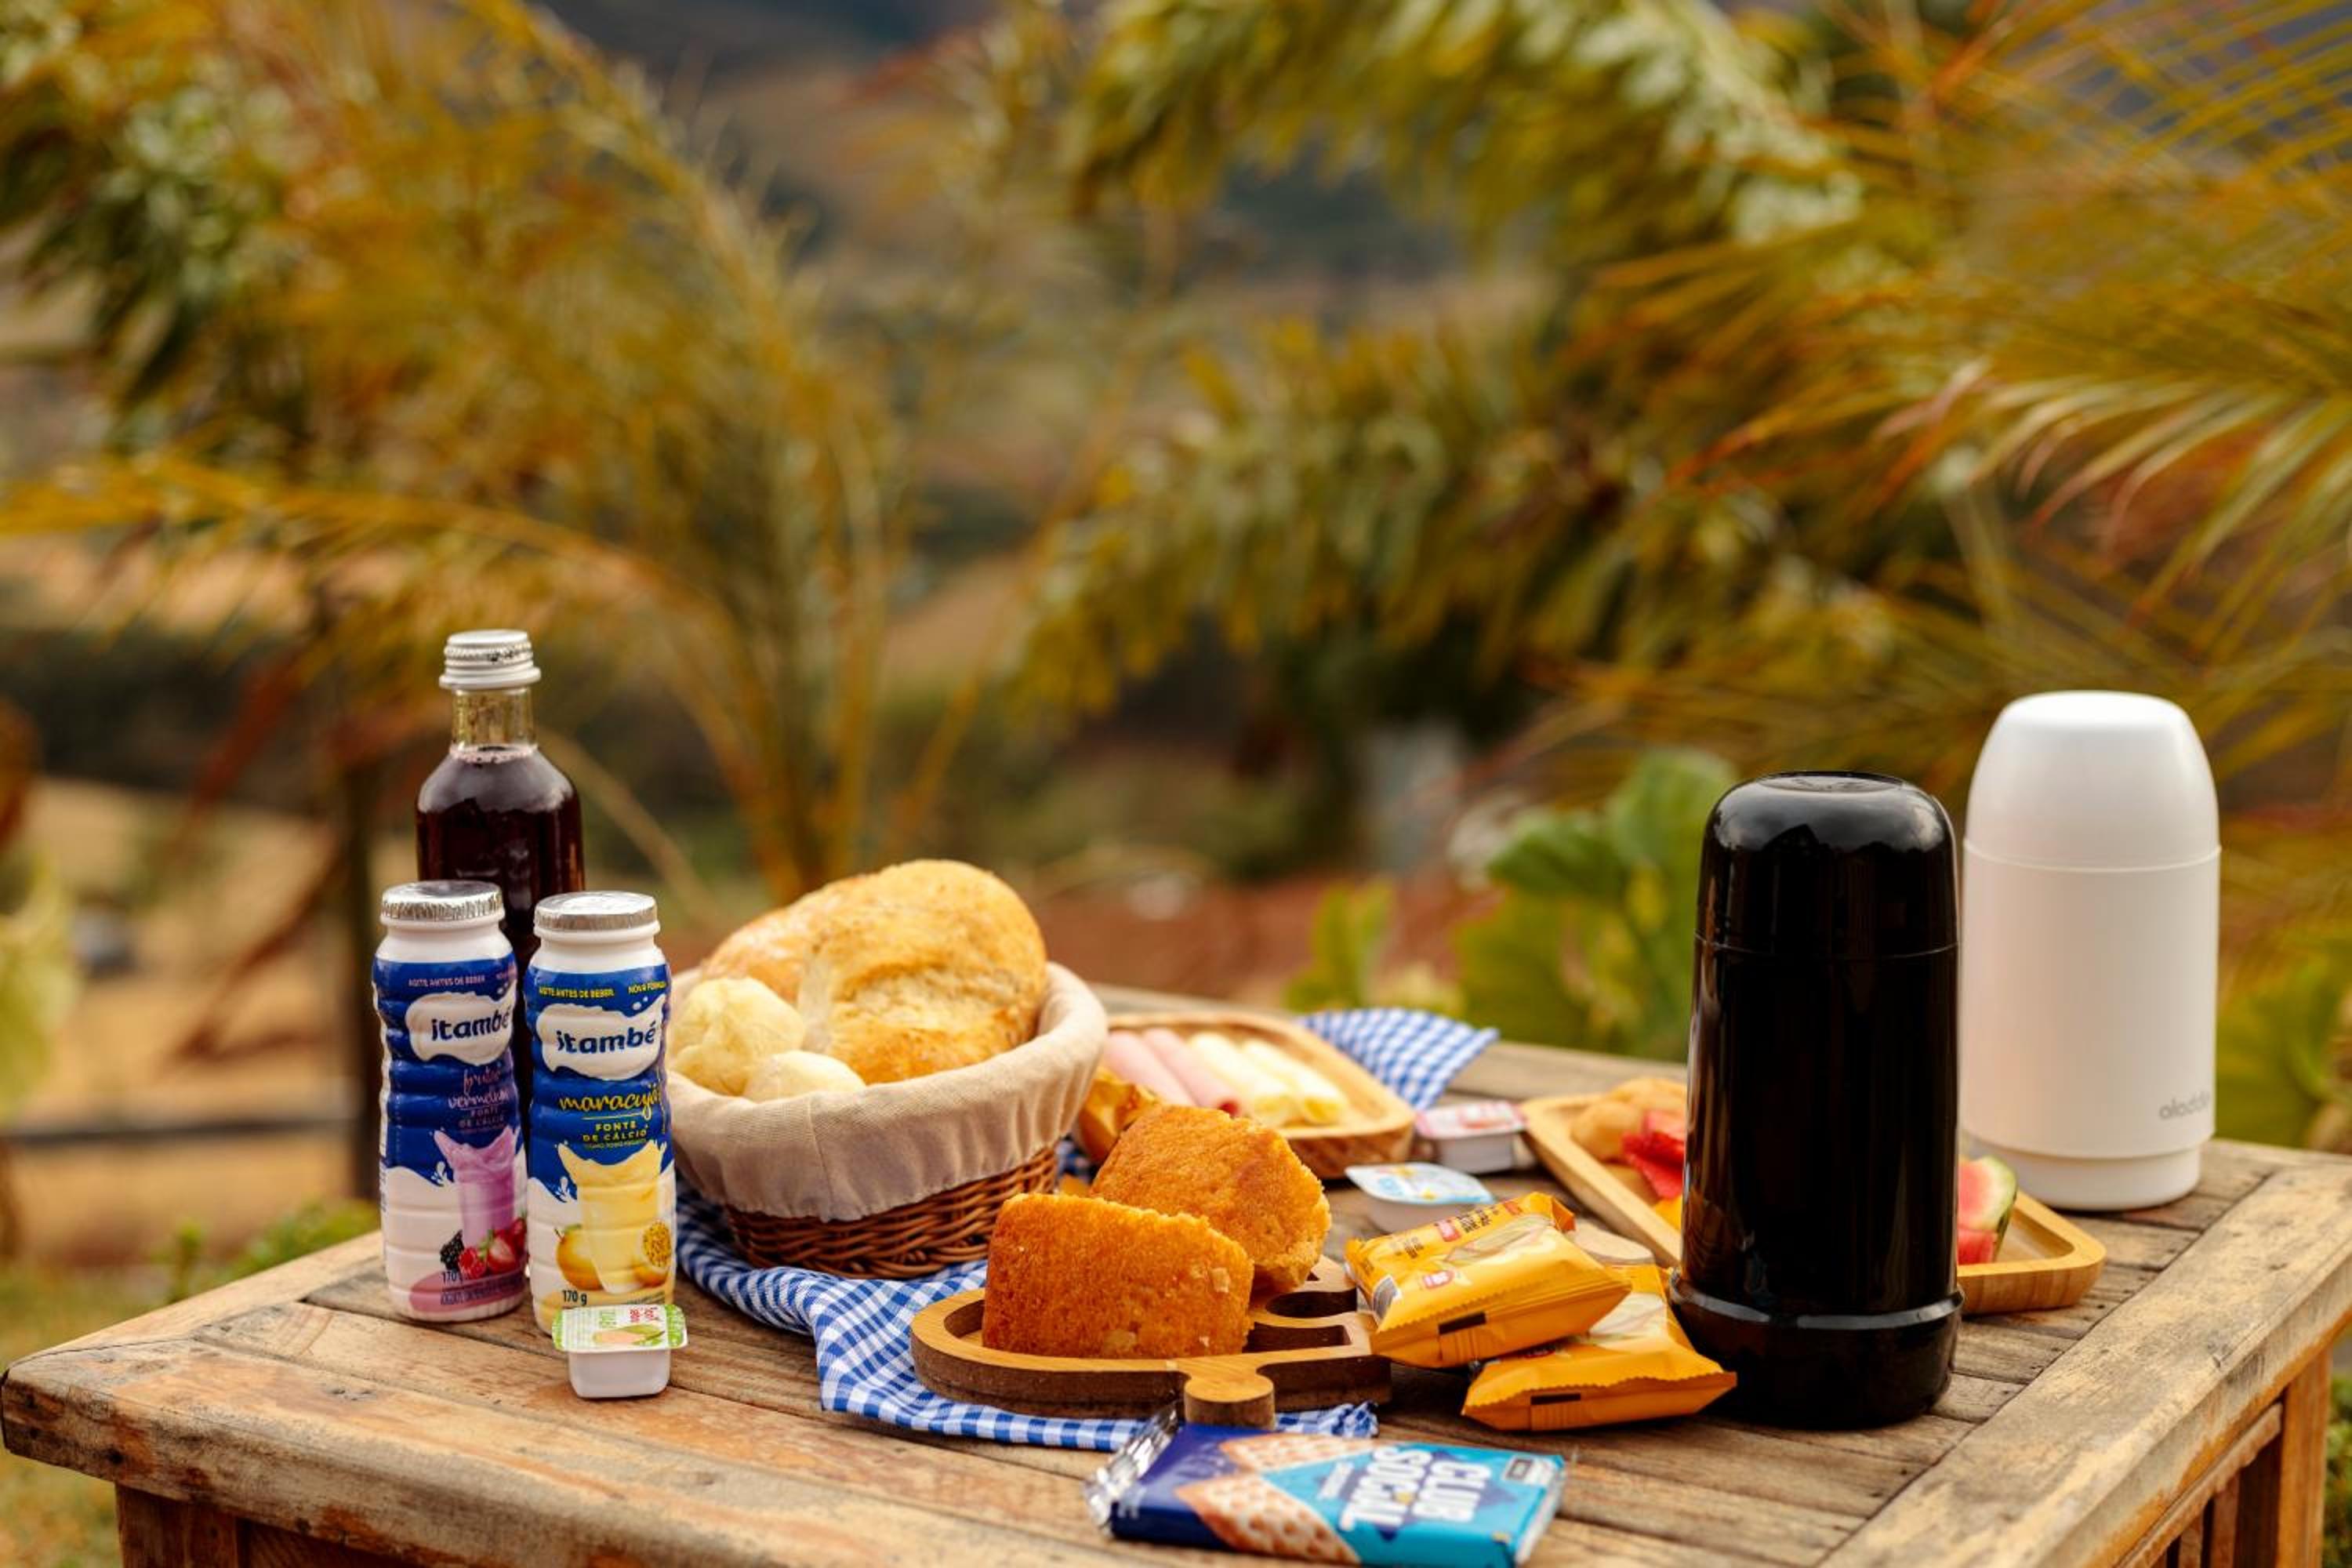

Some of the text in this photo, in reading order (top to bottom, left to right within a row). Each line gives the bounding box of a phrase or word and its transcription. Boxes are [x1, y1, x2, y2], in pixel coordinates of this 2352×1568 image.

[431, 1007, 511, 1041] itambé
[556, 1021, 656, 1054] itambé
[582, 1134, 599, 1142] DE
[595, 1120, 637, 1132] FONTE
[561, 1290, 587, 1305] 170 g
[1338, 1447, 1433, 1531] SOCIAL
[1411, 1460, 1493, 1522] CLUB
